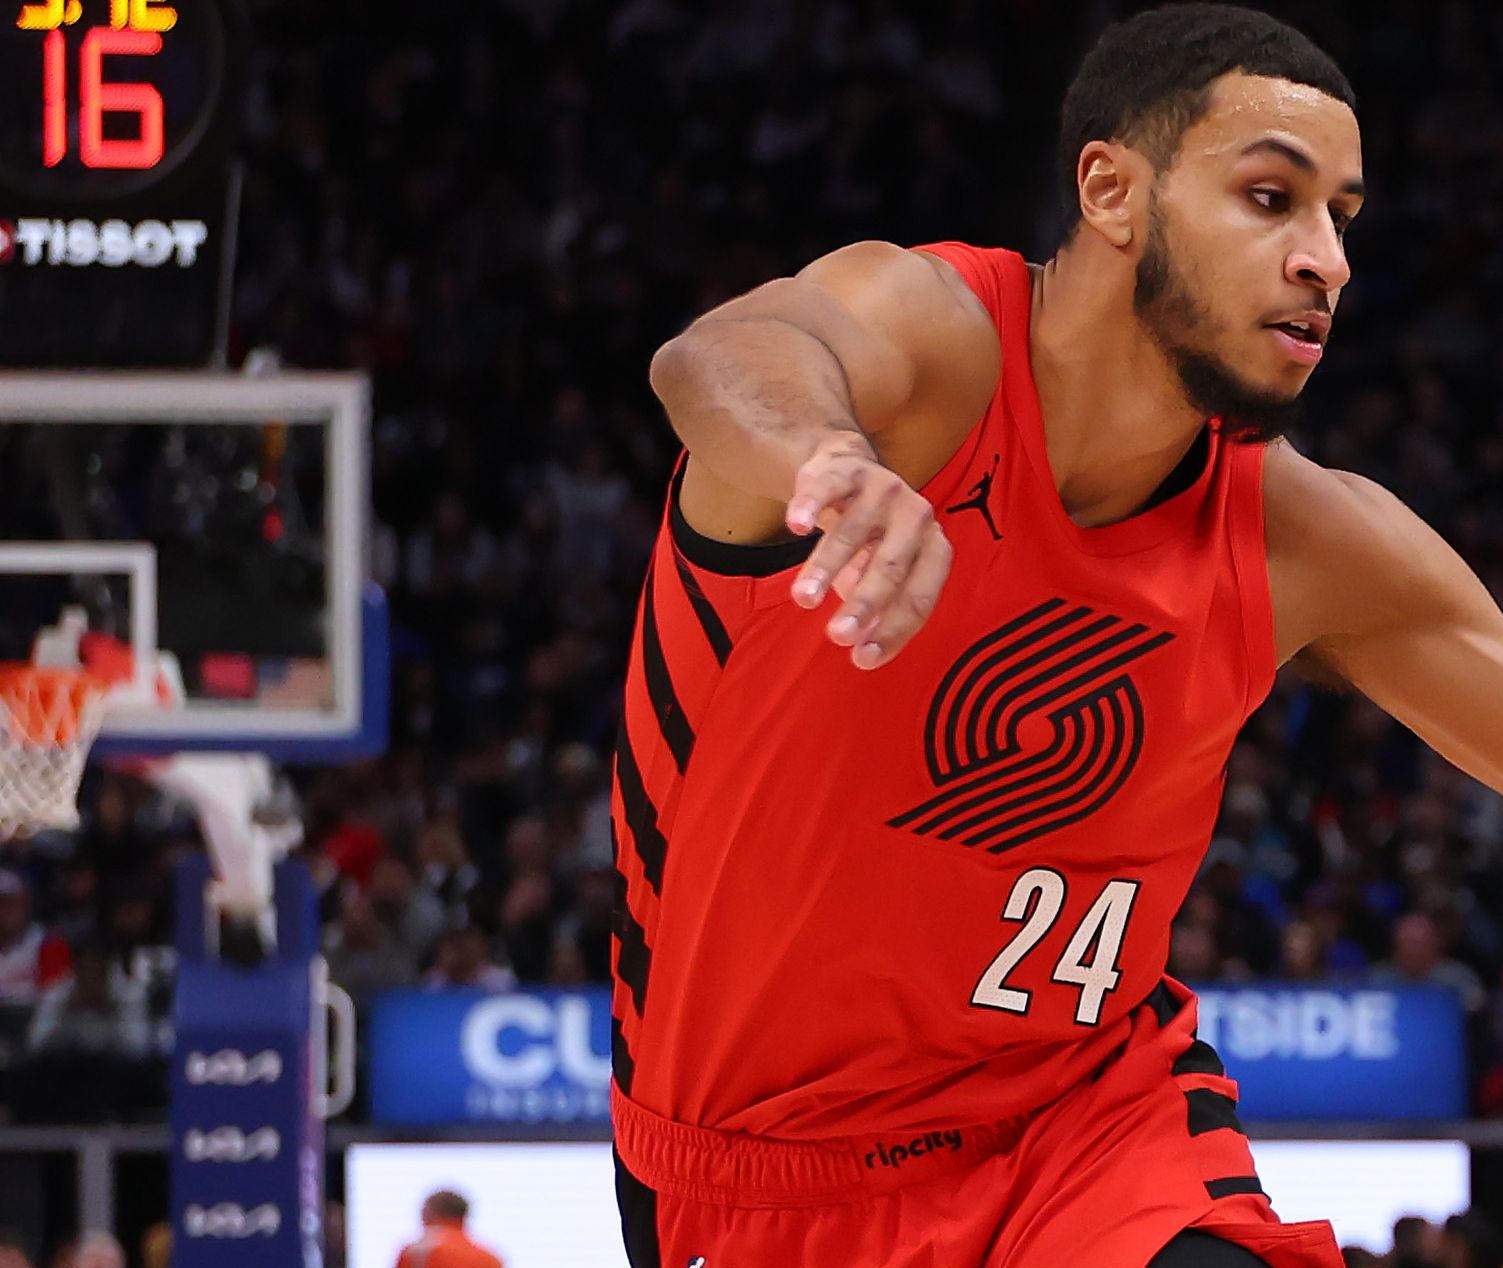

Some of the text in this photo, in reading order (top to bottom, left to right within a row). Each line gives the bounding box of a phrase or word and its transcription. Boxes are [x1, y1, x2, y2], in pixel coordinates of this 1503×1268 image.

[42, 26, 164, 169] 16
[16, 218, 208, 267] TISSOT
[969, 867, 1142, 1027] 24
